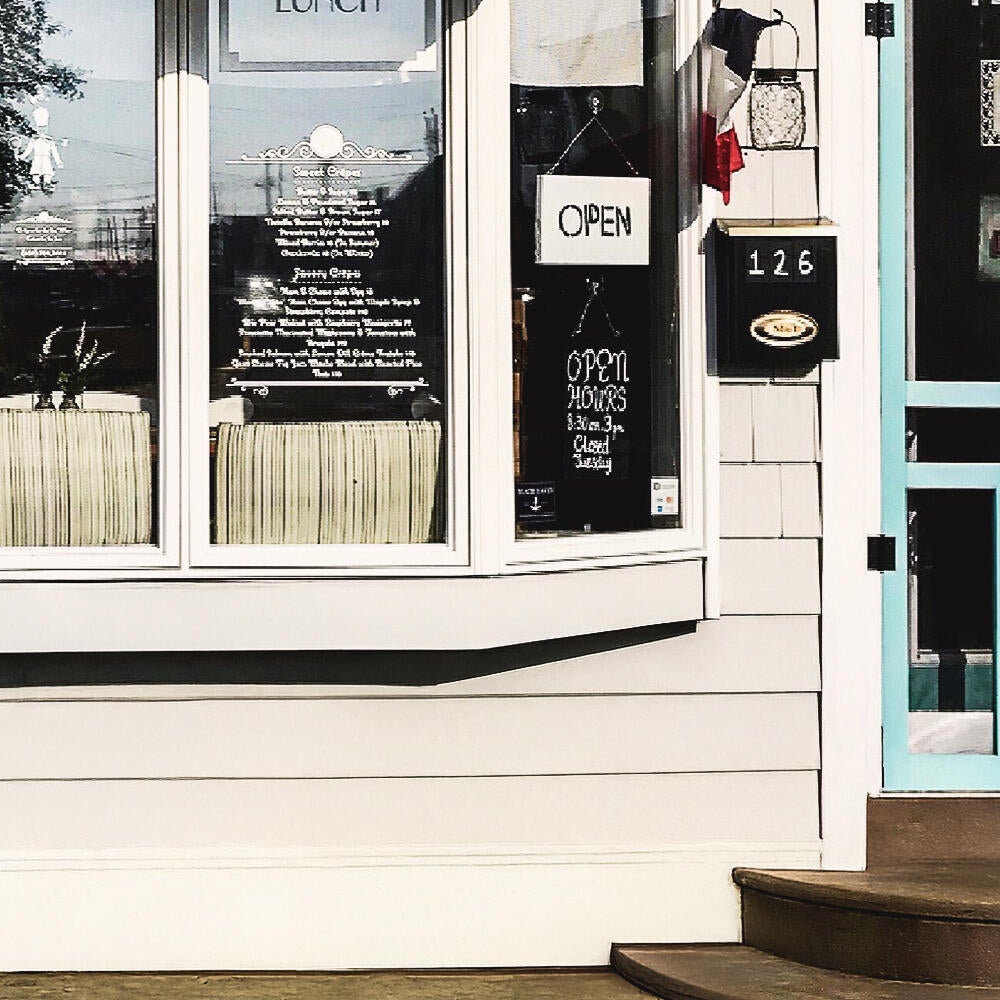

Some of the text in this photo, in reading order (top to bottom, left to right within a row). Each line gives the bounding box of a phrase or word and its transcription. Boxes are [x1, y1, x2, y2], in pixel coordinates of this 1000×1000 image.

[558, 203, 632, 237] OPEN
[567, 349, 630, 383] OPEN
[567, 384, 627, 411] HOURS
[573, 434, 609, 454] Closed
